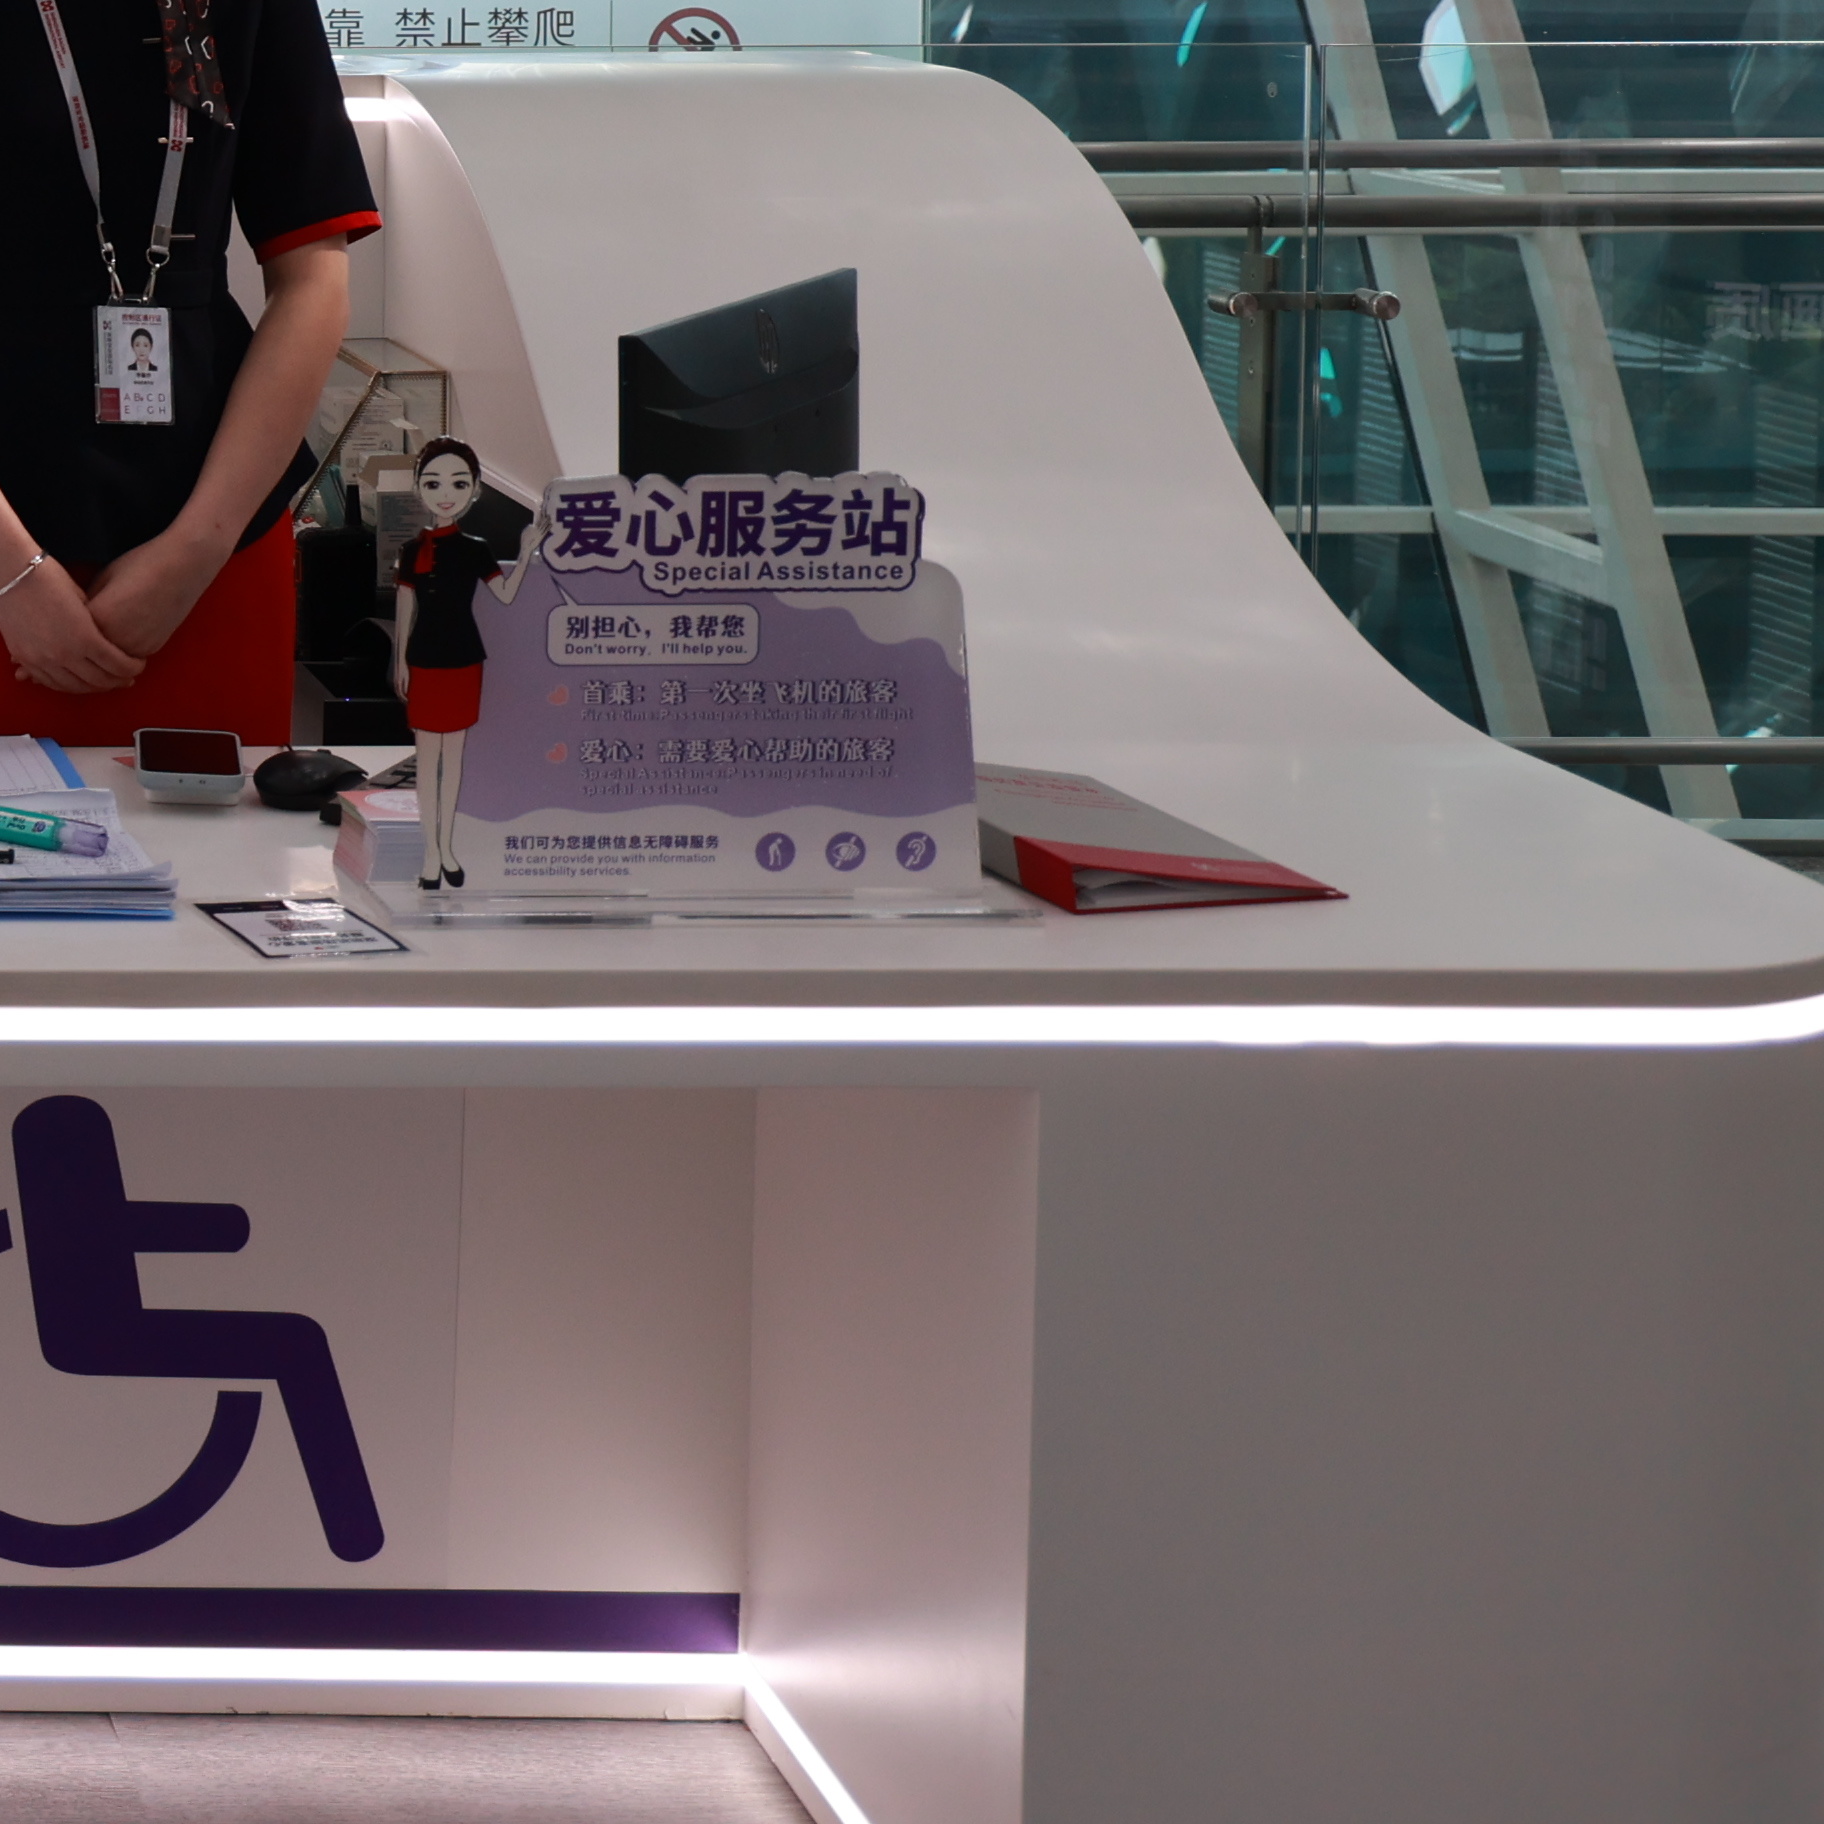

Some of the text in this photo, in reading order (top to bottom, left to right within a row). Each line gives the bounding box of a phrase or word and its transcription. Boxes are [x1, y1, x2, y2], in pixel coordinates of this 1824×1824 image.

[325, 7, 576, 47] 靠 禁止攀爬
[554, 486, 914, 558] 爱心服务站
[654, 560, 901, 586] Special Assistance
[565, 614, 746, 641] 别担心，我帮您
[565, 643, 602, 655] Don't
[662, 642, 679, 654] I'll
[682, 643, 714, 655] help
[717, 644, 747, 655] you.
[580, 737, 896, 765] 爱心：需要爱心帮助的旅客
[505, 835, 720, 850] 我们可为您提供信息无障碍服务
[504, 853, 716, 865] We can provide you with information
[504, 867, 631, 877] accessibility services.
